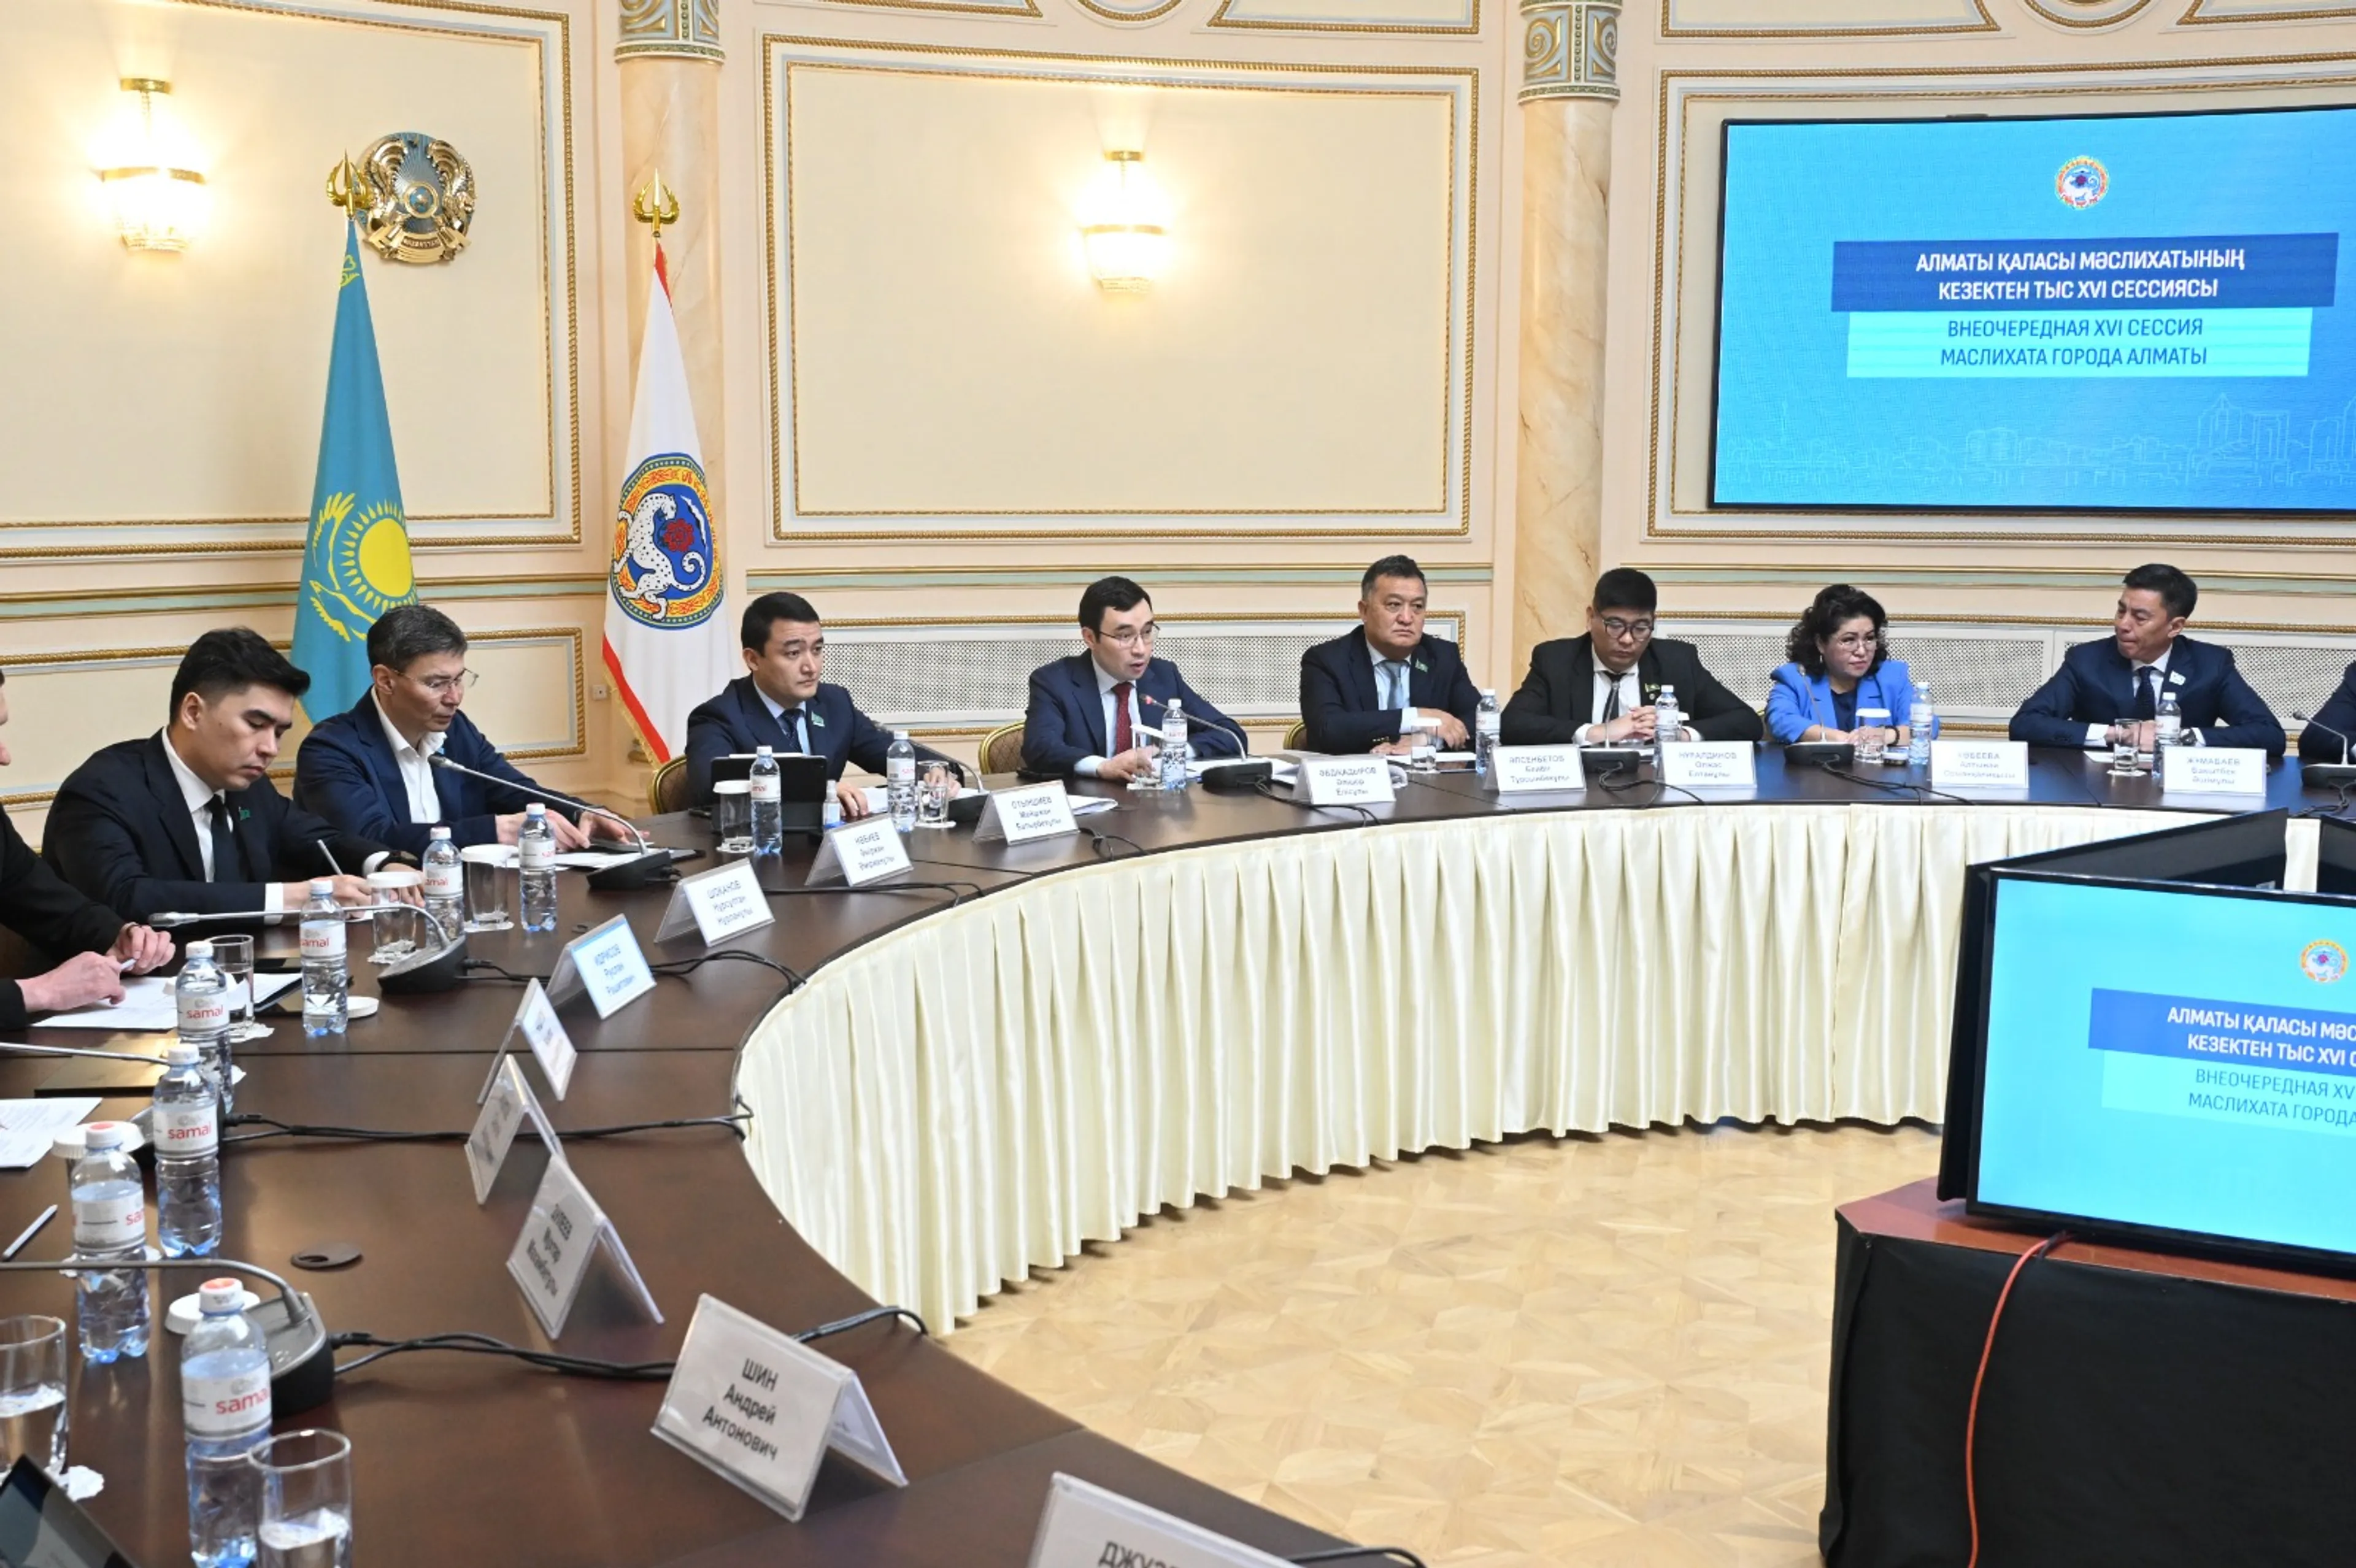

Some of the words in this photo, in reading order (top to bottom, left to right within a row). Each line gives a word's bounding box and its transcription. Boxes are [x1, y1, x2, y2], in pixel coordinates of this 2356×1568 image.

[1915, 253, 1993, 272] АЛМАТЫ
[1998, 252, 2076, 274] ҚАЛАСЫ
[2079, 248, 2245, 271] МӘСЛИХАТЫНЫҢ
[1939, 281, 2030, 300] КЕЗЕКТЕН
[2033, 281, 2074, 299] ТЫС
[2077, 280, 2107, 298] XVI
[2111, 279, 2219, 298] СЕССИЯСЫ
[1948, 320, 2089, 339] ВНЕОЧЕРЕДНАЯ
[2093, 320, 2122, 336] XVI
[2128, 318, 2203, 336] СЕССИЯ
[1941, 348, 2047, 366] МАСЛИХАТА
[2052, 348, 2123, 367] ГОРОДА
[2127, 347, 2207, 365] АЛМАТЫ
[299, 936, 329, 948] amal
[186, 1004, 224, 1019] samal
[2167, 1007, 2239, 1029] АЛМАТЫ
[2243, 1014, 2316, 1038] ҚАЛАСЫ
[2187, 1033, 2273, 1058] КЕЗЕКТЕН
[2276, 1042, 2315, 1062] ТЫС
[2317, 1048, 2346, 1066] XVI
[2195, 1068, 2328, 1098] ВНЕОЧЕРЕДНАЯ
[2188, 1092, 2288, 1118] МАСЛИХАТА
[167, 1121, 212, 1140] samal
[741, 1358, 779, 1393] ШИН
[215, 1388, 270, 1415] sama
[723, 1383, 777, 1426] Андрей
[702, 1405, 779, 1462] Антонович
